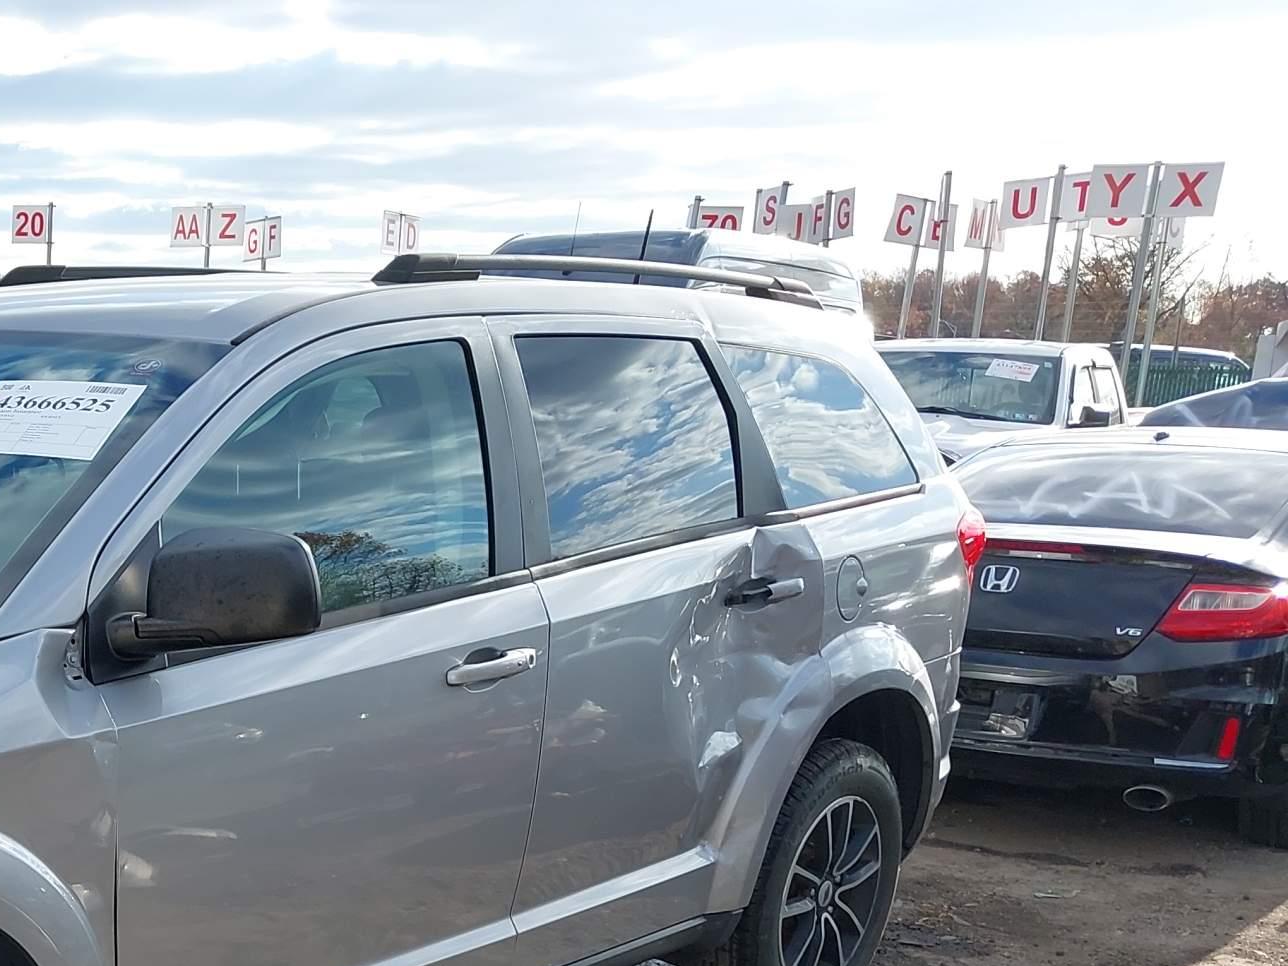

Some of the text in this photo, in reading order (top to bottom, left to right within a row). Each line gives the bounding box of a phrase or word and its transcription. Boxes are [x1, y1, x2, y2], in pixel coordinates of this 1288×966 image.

[1013, 187, 1038, 219] U
[1073, 181, 1090, 212] T
[1104, 173, 1136, 208] Y
[1169, 172, 1208, 207] X
[763, 195, 777, 226] S
[837, 197, 850, 230] G
[896, 205, 915, 236] C
[15, 212, 44, 237] 20
[174, 214, 200, 240] AA
[219, 213, 237, 239] Z
[268, 224, 277, 251] F
[386, 219, 395, 245] E
[407, 223, 416, 249] D
[248, 228, 257, 253] G
[1116, 627, 1143, 636] V6
